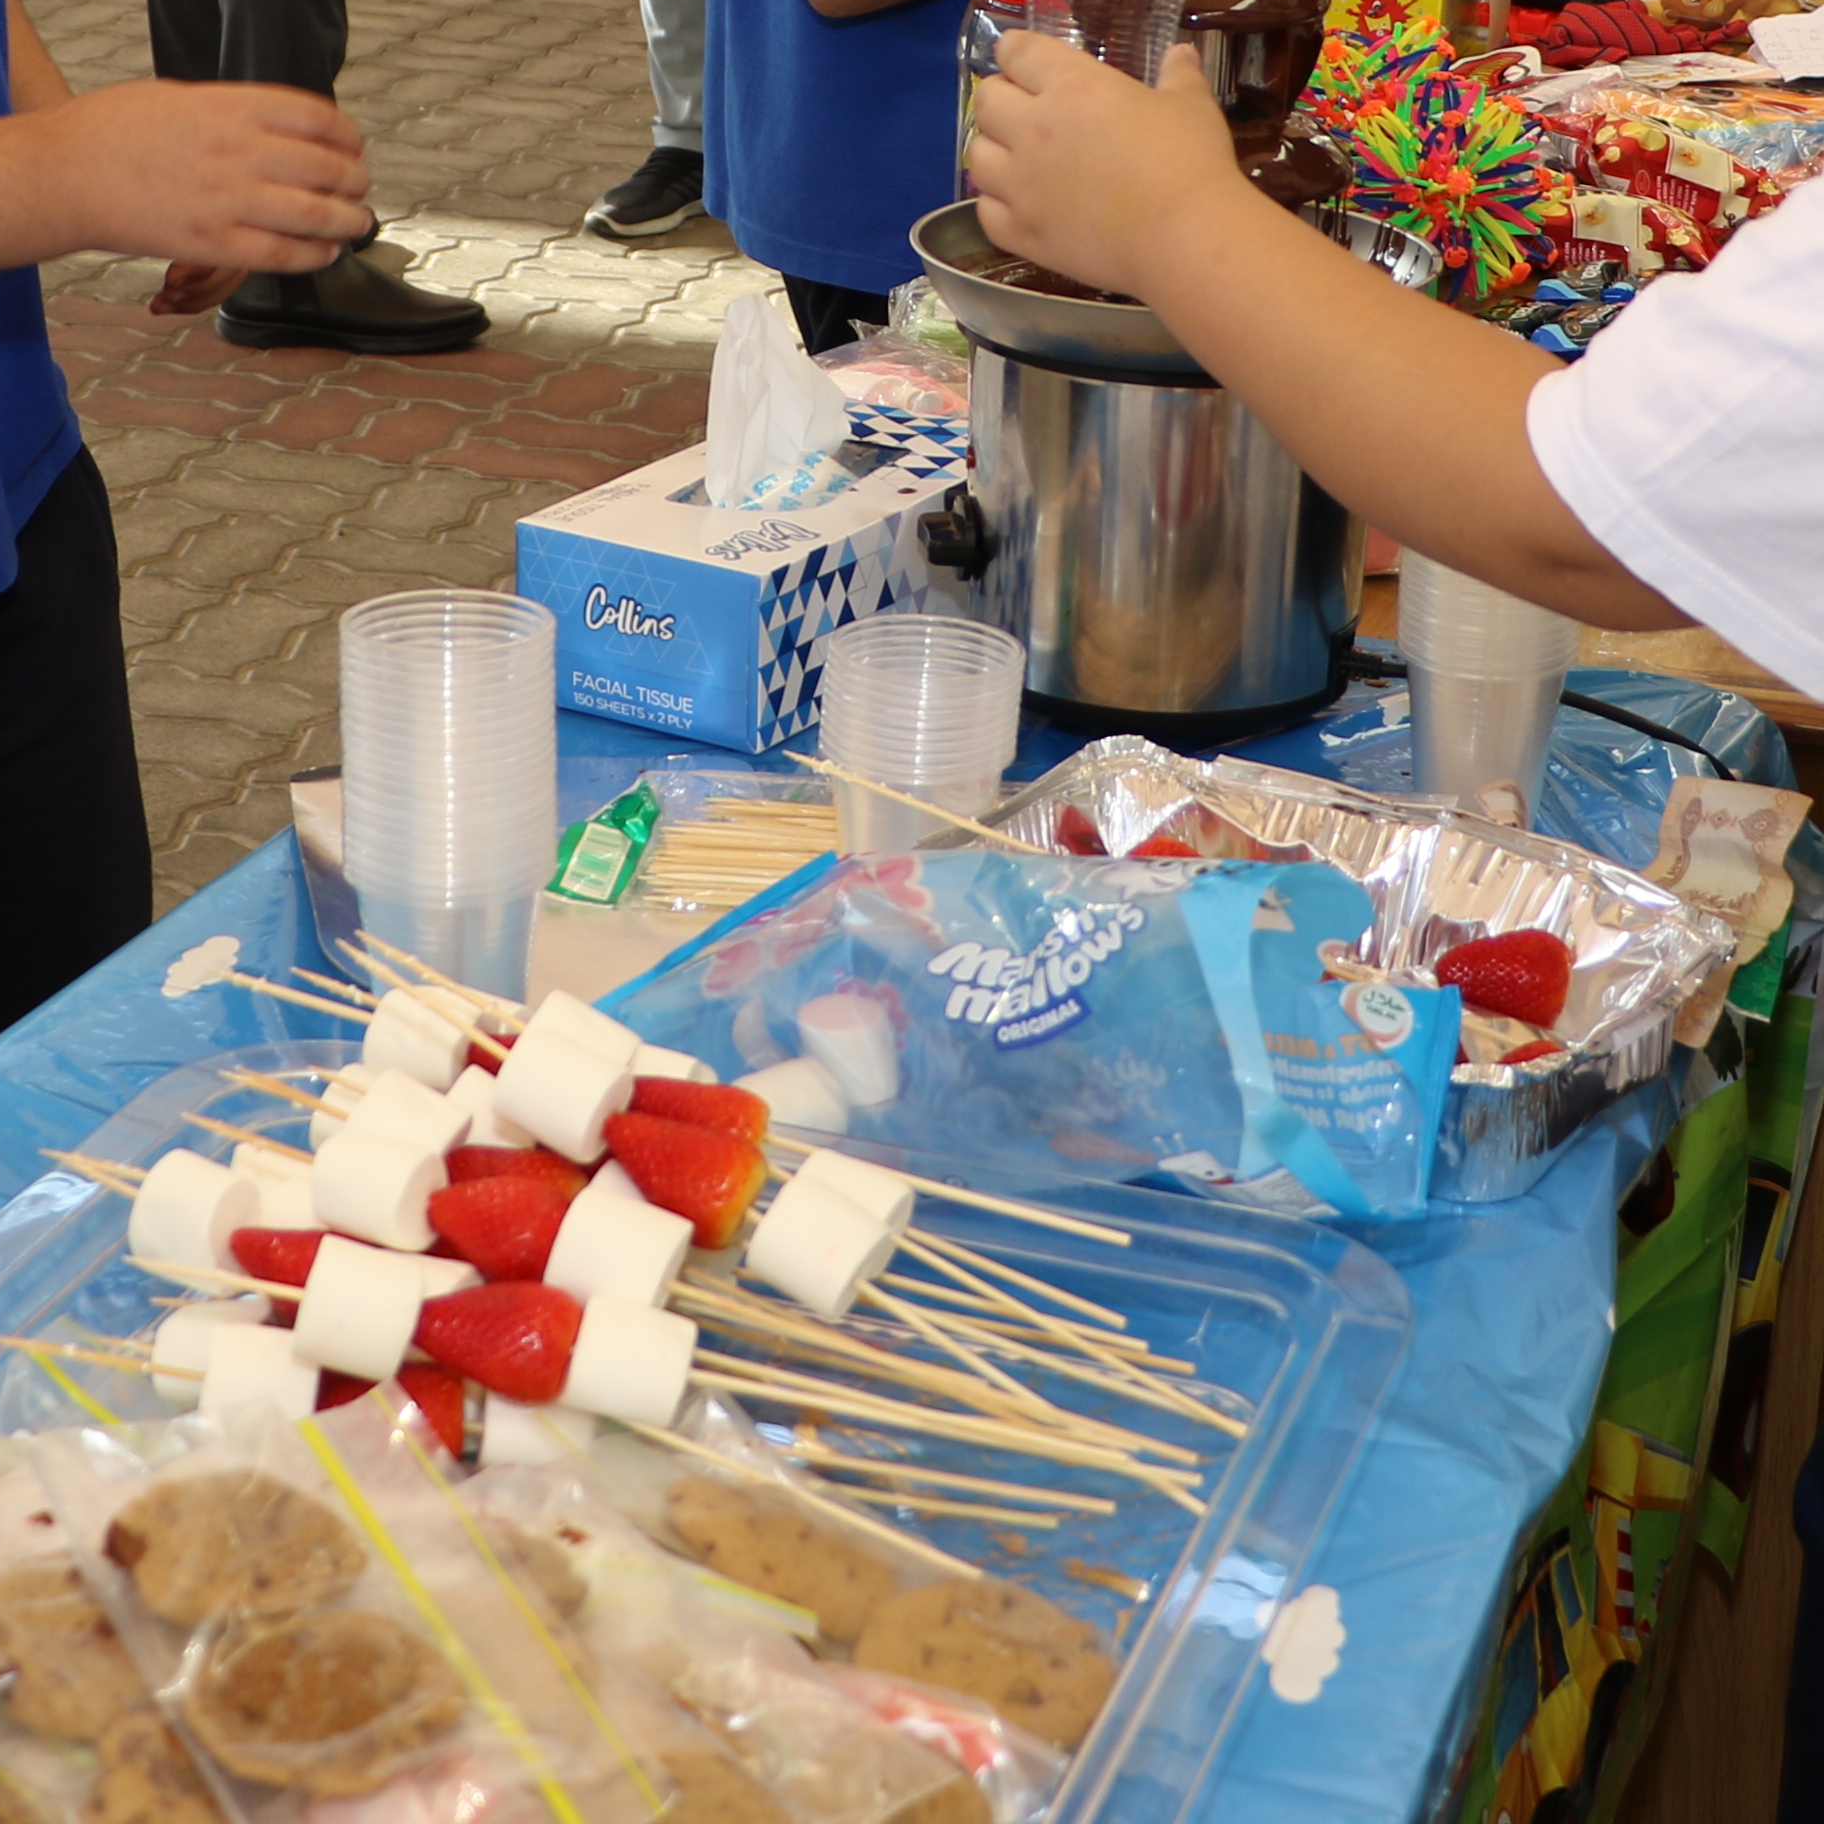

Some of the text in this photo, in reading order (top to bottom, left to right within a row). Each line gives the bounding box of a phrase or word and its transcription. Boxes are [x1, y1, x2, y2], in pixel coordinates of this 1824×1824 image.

[584, 582, 676, 641] Collins
[572, 671, 694, 714] FACIAL TISSUE
[573, 691, 594, 707] 150
[596, 696, 646, 721] SHEETS
[945, 905, 1146, 1024] mallows
[997, 998, 1082, 1044] ORIGINAL
[1362, 989, 1405, 1012] حلال
